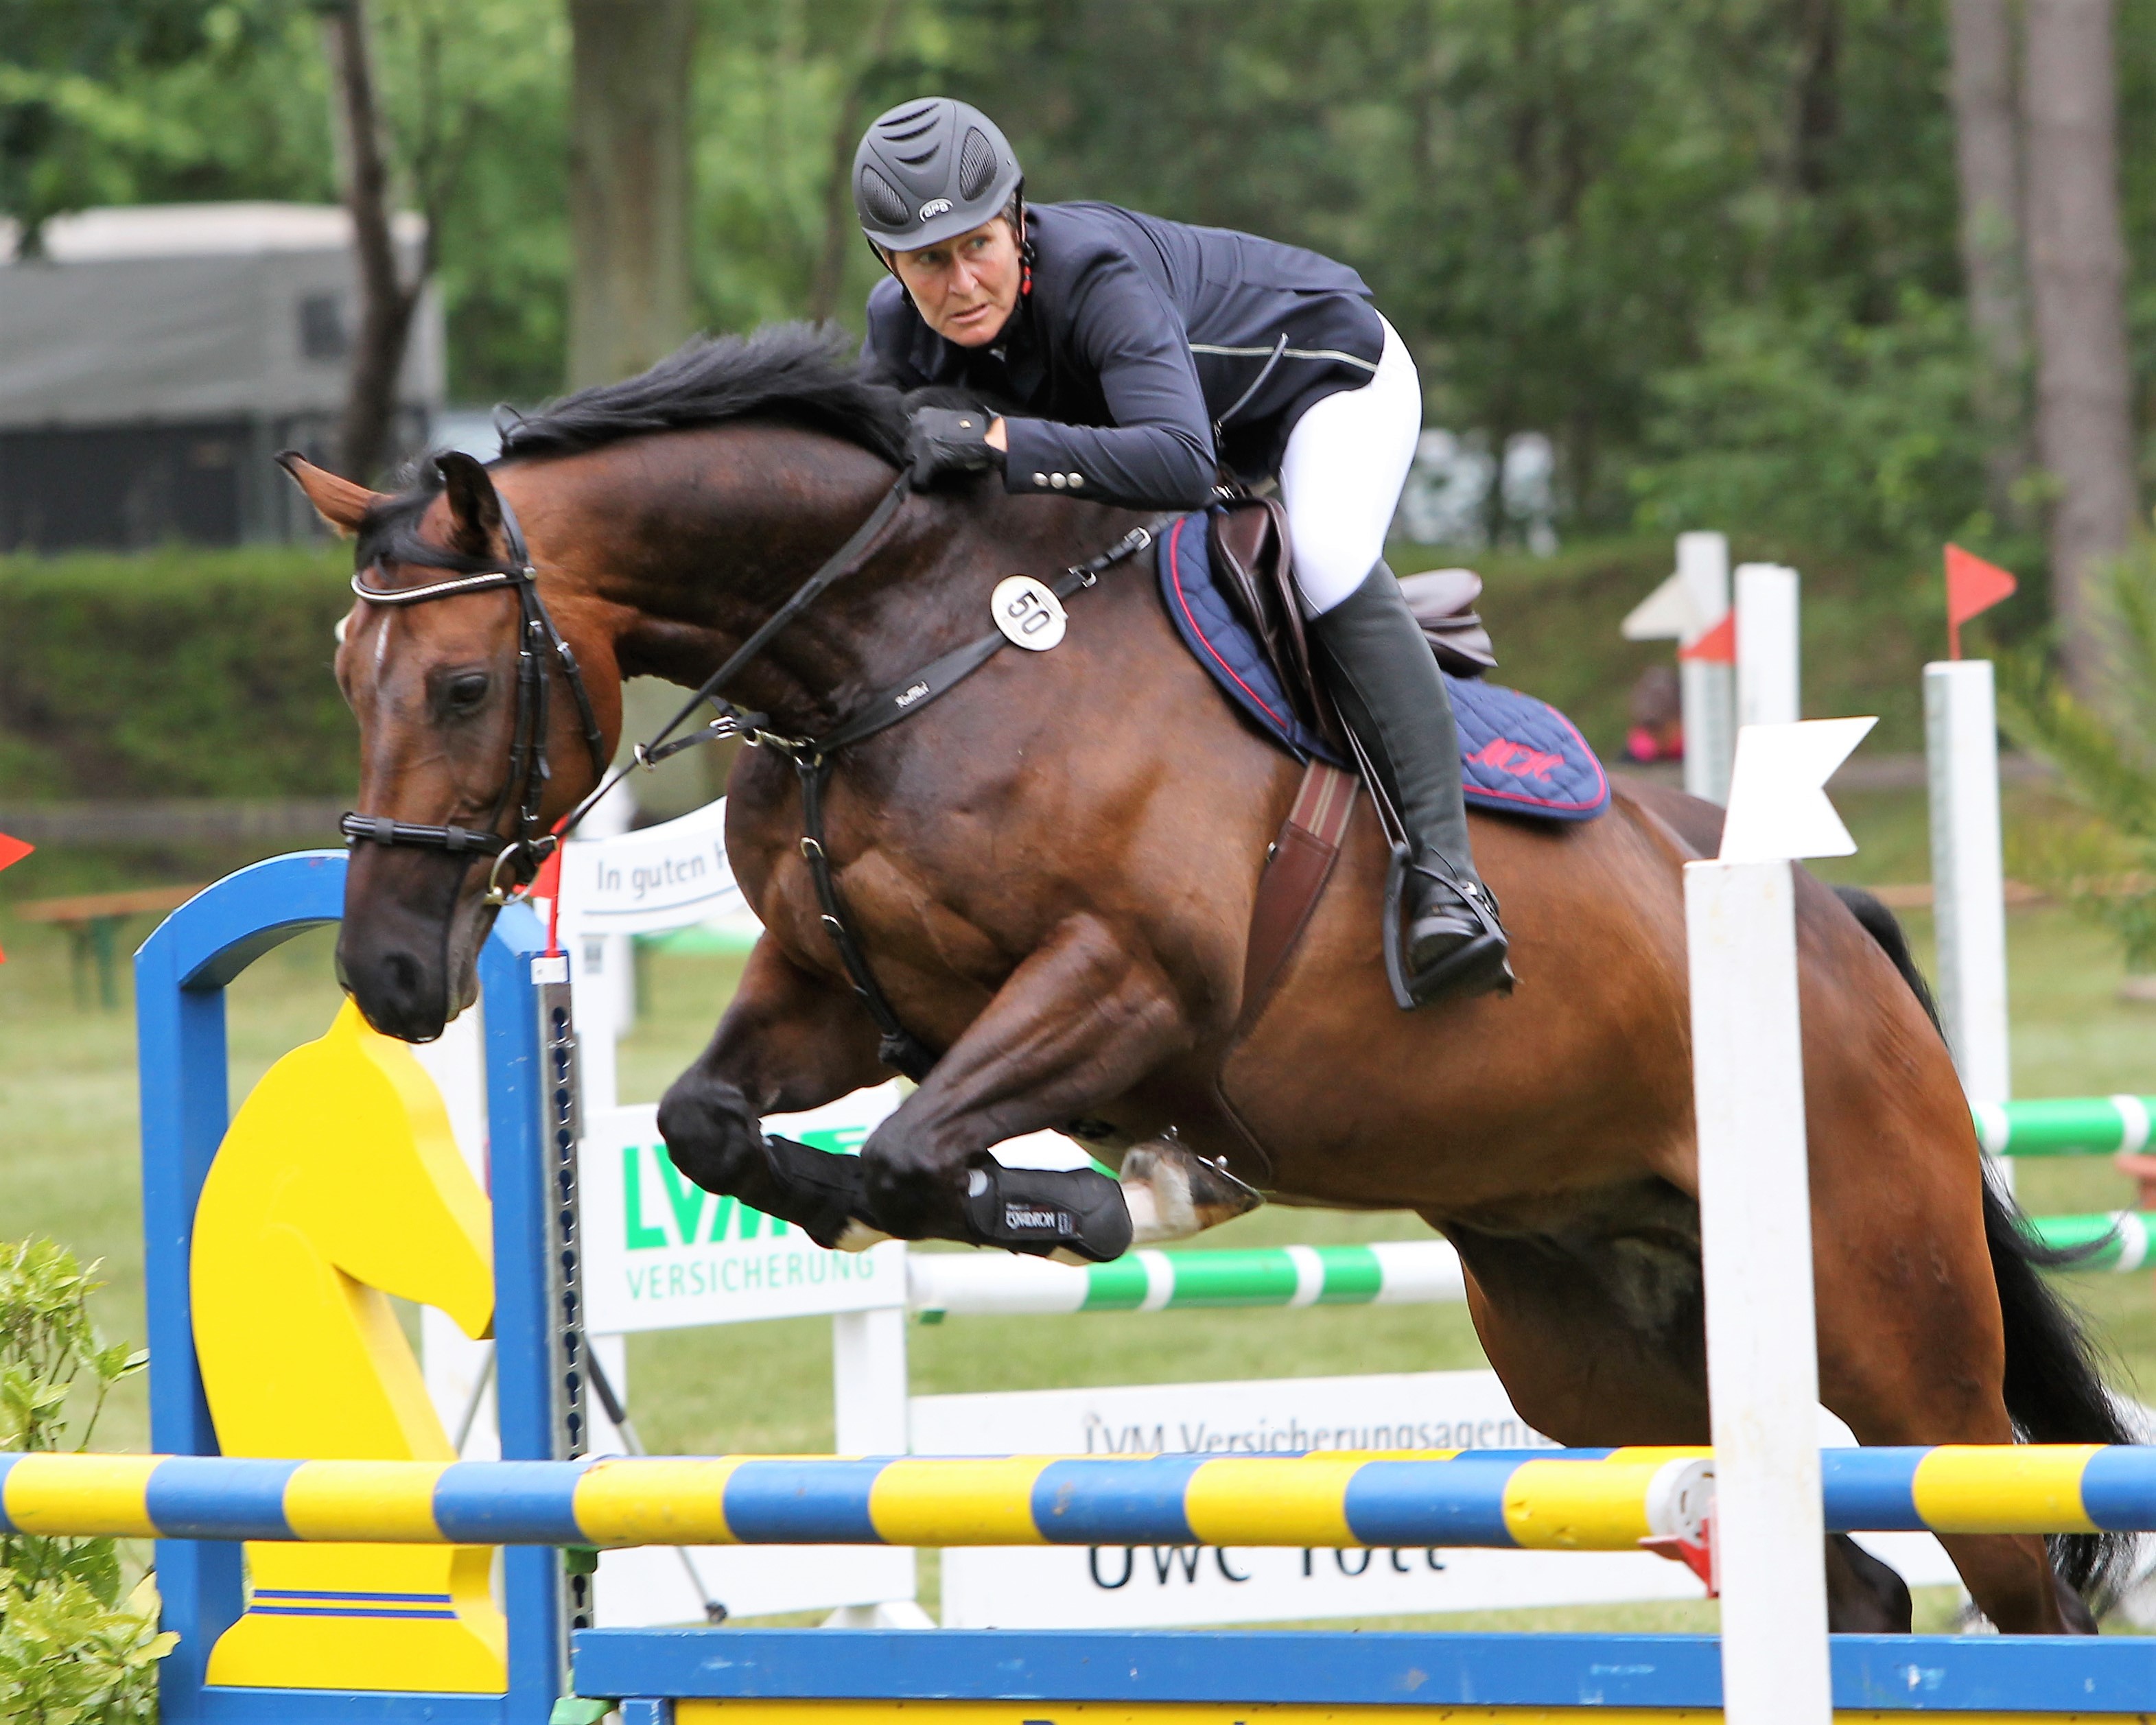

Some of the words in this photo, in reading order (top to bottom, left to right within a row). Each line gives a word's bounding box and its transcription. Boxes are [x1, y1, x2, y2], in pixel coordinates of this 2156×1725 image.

[1008, 591, 1050, 635] 50
[598, 860, 620, 891] In
[626, 1249, 874, 1300] VERSICHERUNG
